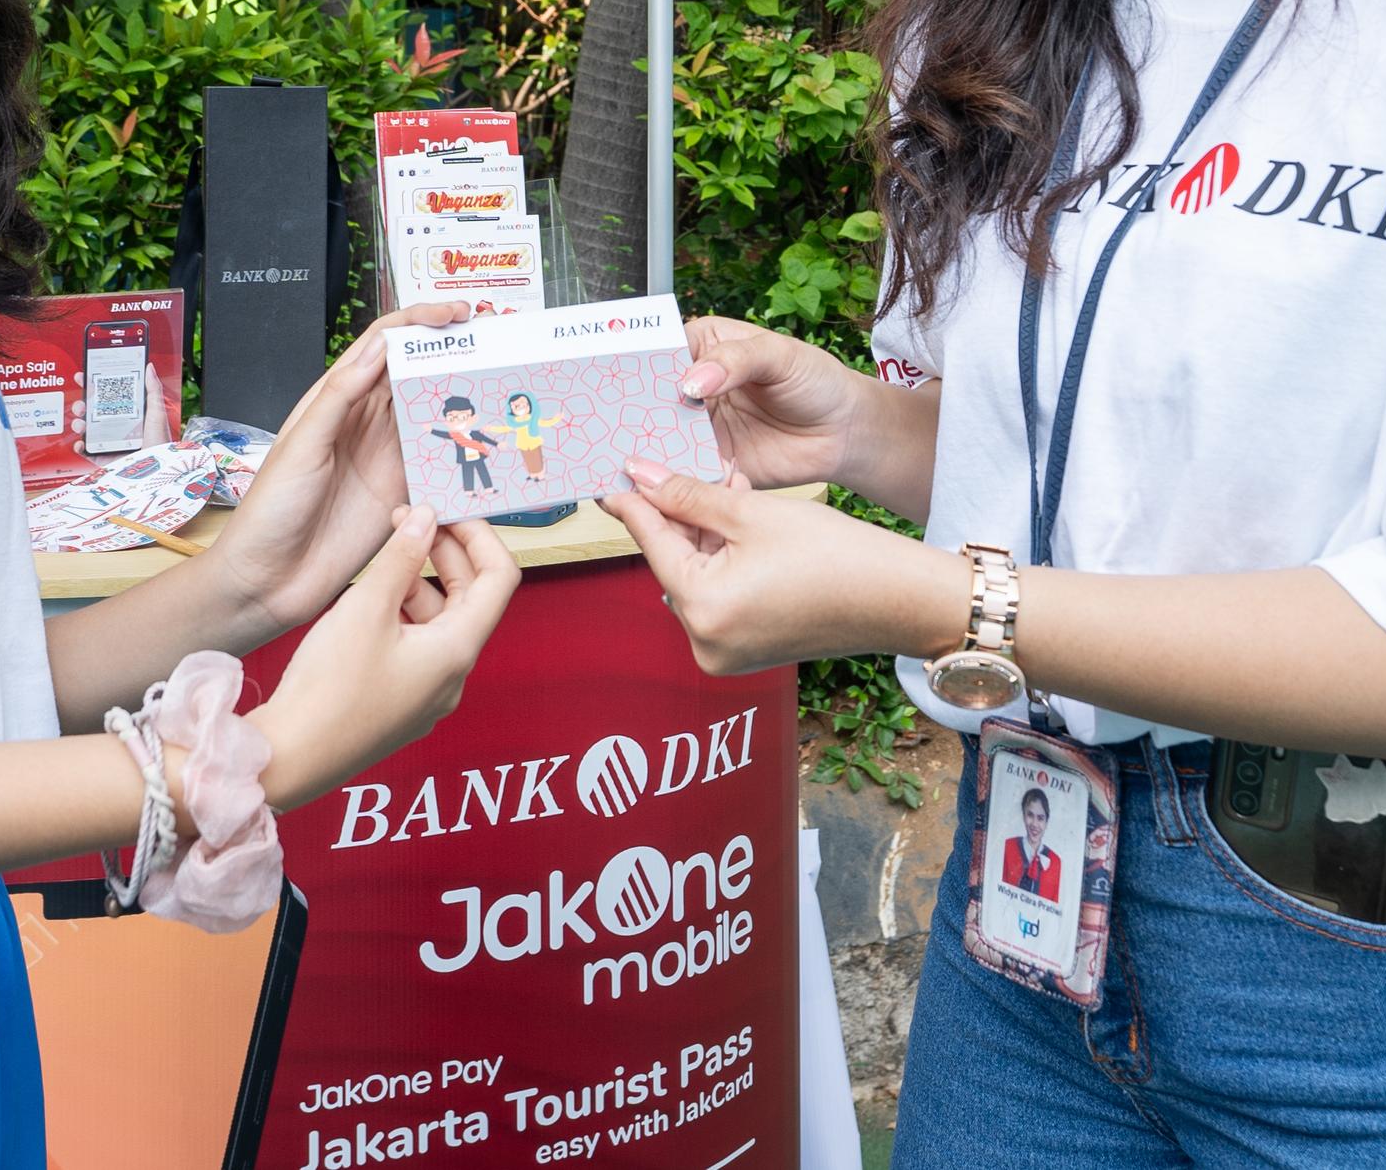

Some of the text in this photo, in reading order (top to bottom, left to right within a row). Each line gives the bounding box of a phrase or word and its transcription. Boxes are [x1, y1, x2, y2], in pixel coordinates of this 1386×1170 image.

[425, 191, 505, 214] Vaganza
[441, 249, 522, 275] Vaganza
[221, 269, 311, 283] BANK DKI
[111, 300, 173, 313] BANK DKI
[554, 315, 662, 338] BANK DKI
[404, 333, 475, 355] SimPel
[25, 360, 56, 374] Saja
[19, 376, 65, 389] Mobile
[330, 705, 758, 850] BANK DKI
[1006, 762, 1073, 794] BANK DKI
[418, 834, 754, 973] JakOne
[583, 909, 753, 1005] mobile
[299, 1054, 504, 1114] JakOne Pay
[297, 1025, 753, 1170] Jakarta Tourist Pass
[535, 1062, 754, 1165] easy with JakCard
